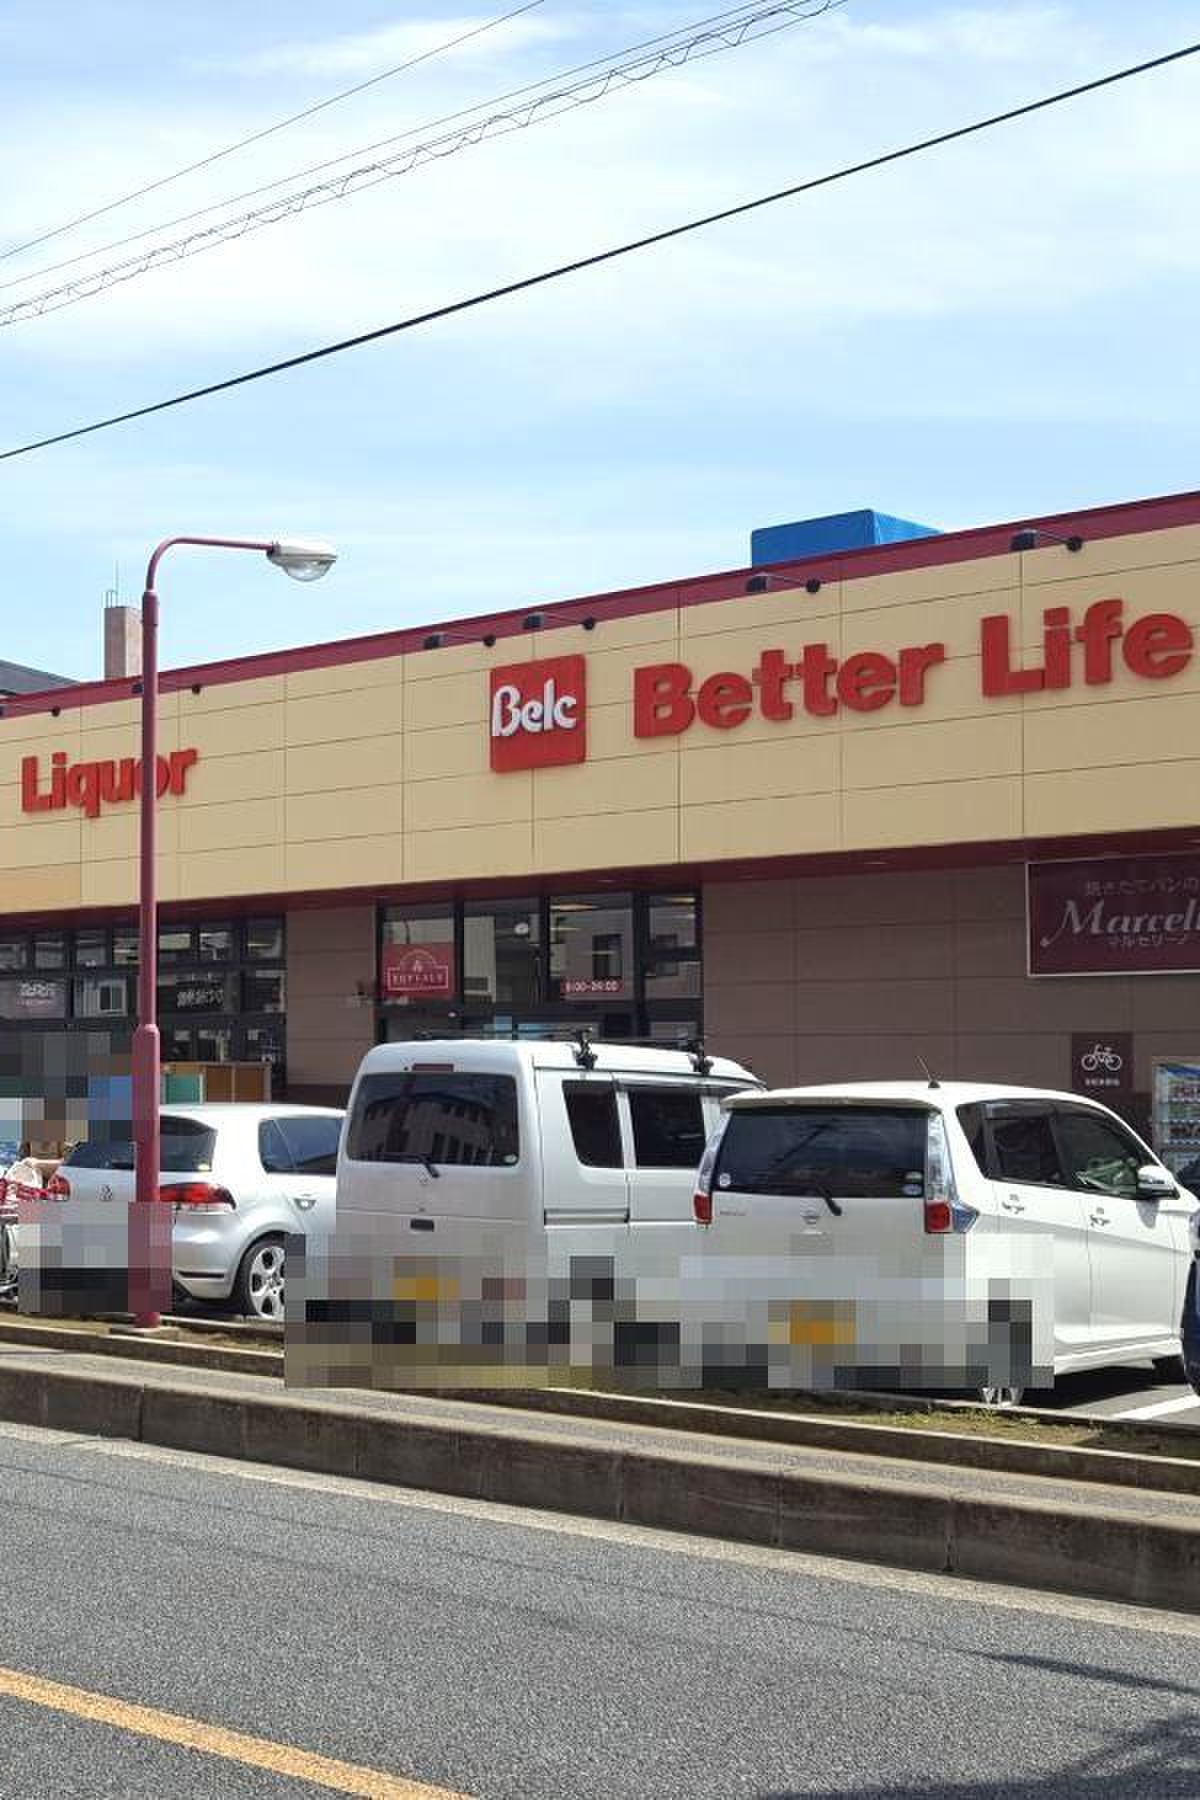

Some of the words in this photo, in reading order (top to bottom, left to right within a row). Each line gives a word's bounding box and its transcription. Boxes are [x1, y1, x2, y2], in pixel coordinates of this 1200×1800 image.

[634, 642, 944, 739] Better
[981, 599, 1194, 697] Life
[492, 678, 577, 736] Belc
[21, 748, 198, 817] Liquor
